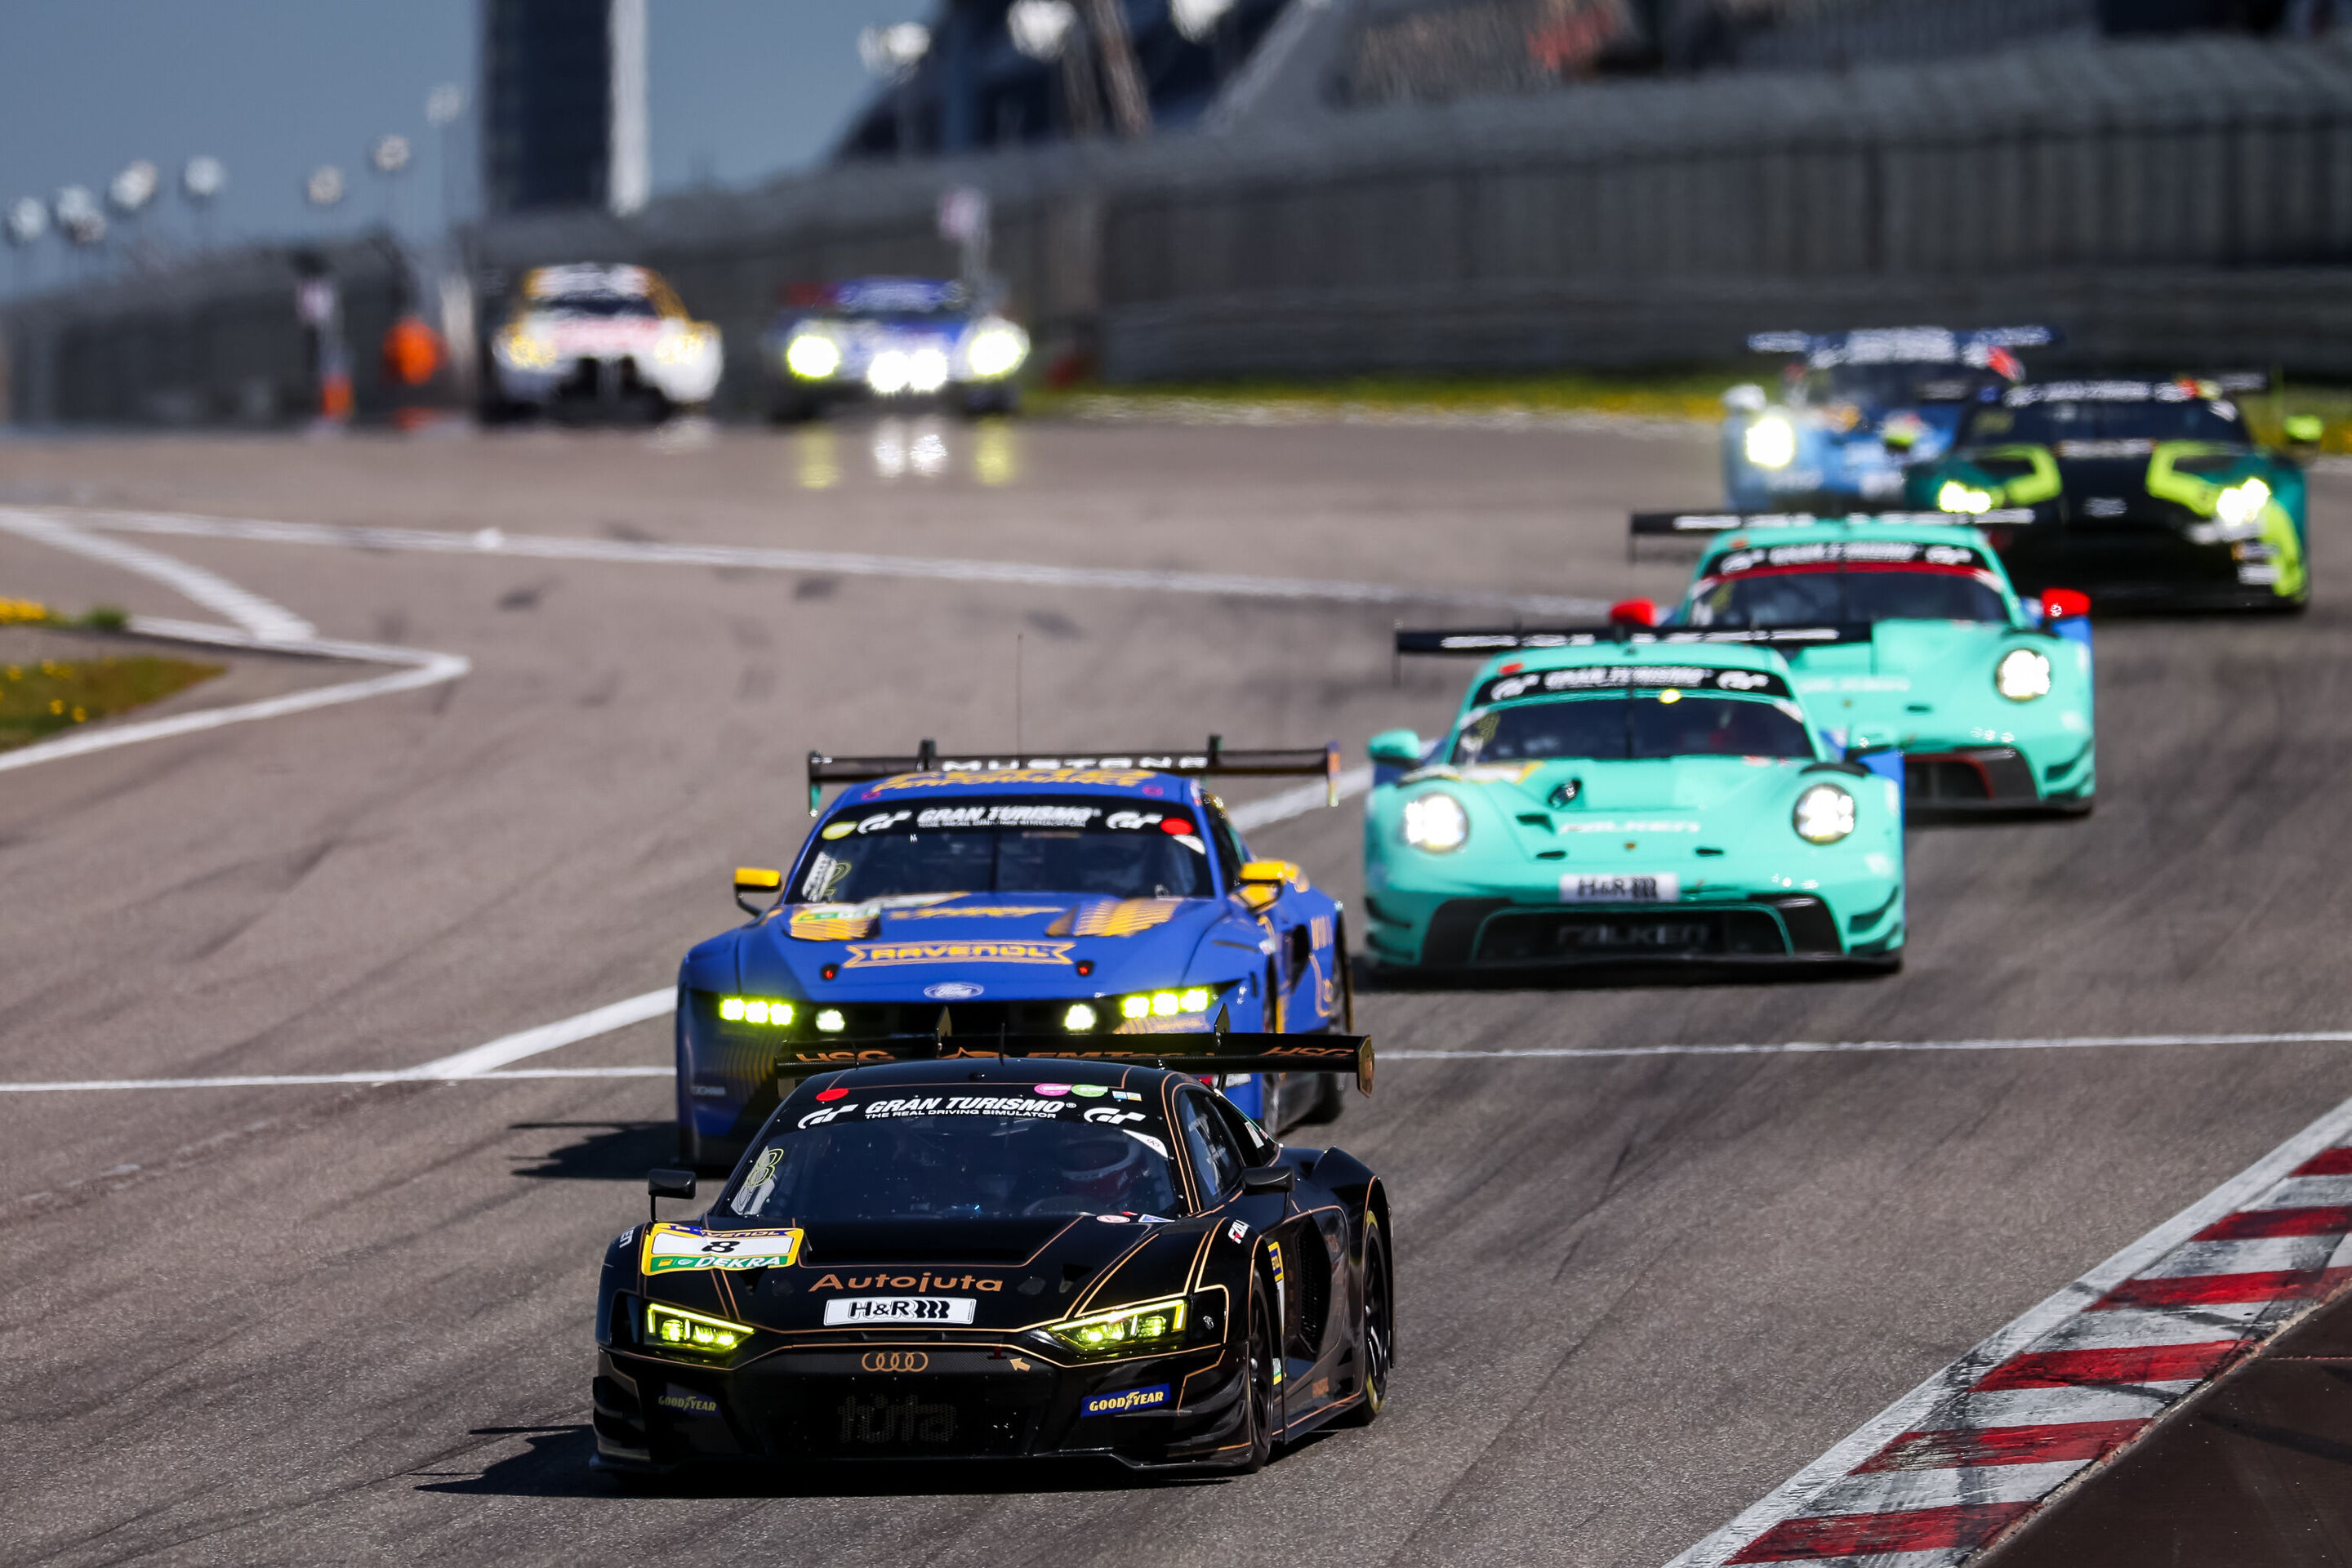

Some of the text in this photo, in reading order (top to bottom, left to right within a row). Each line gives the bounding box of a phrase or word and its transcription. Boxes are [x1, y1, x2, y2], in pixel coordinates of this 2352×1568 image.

[871, 946, 1050, 960] RAVENOL
[865, 1098, 942, 1114] GRAN
[945, 1097, 1065, 1113] TURISMO
[982, 1109, 1057, 1119] SIMULATOR
[702, 1241, 741, 1253] 8
[694, 1256, 780, 1268] DEKRA
[808, 1272, 1004, 1293] Autojuta
[849, 1300, 911, 1318] H&R
[658, 1396, 717, 1411] GOODYEAR
[1089, 1391, 1165, 1410] GOODYEAR
